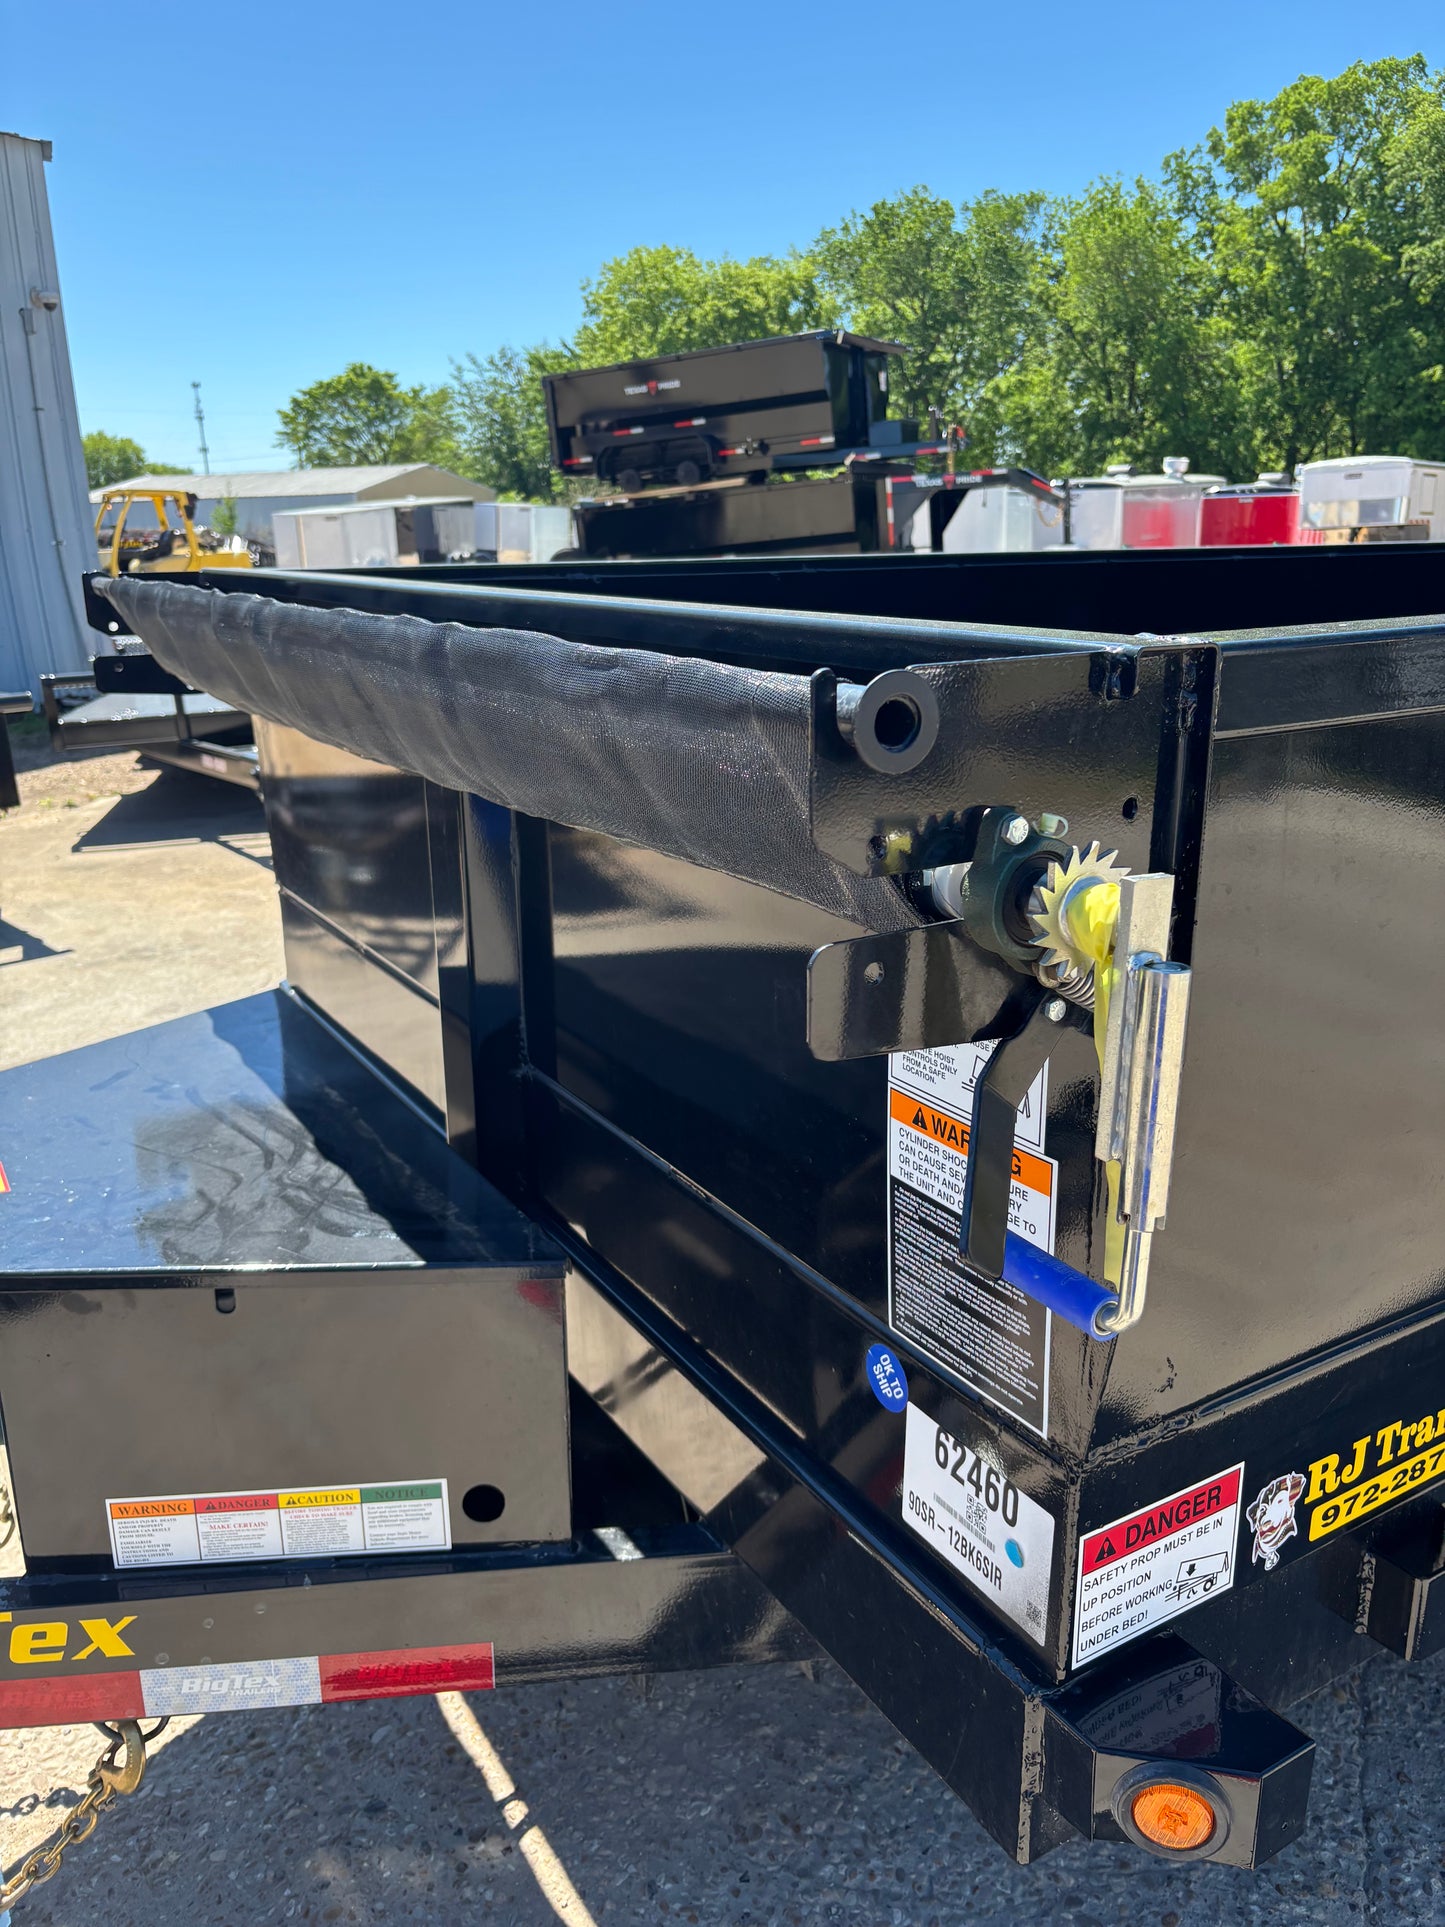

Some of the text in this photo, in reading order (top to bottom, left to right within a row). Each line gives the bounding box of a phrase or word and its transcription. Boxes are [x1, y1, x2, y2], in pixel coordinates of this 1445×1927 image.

[902, 1054, 922, 1068] FROM
[928, 1066, 946, 1080] SAFE
[904, 1050, 938, 1067] ONTROLS
[939, 1063, 958, 1076] ONLY
[934, 1049, 956, 1065] HOIST
[902, 1063, 937, 1085] LOCATION.
[899, 1127, 940, 1155] CYLINDER
[899, 1140, 916, 1157] CAN
[917, 1148, 947, 1174] CAUSE
[899, 1153, 912, 1168] OR
[912, 1160, 940, 1184] DEATH
[898, 1166, 914, 1183] THE
[916, 1175, 936, 1194] UNIT
[936, 1186, 956, 1206] AND
[1022, 1219, 1037, 1235] TO
[873, 1363, 893, 1398] SHIP
[880, 1354, 904, 1399] OK TO
[935, 1425, 1019, 1528] 62460
[1304, 1435, 1371, 1505] RJ
[218, 1498, 270, 1510] DANGER
[297, 1492, 354, 1505] CAUTION
[375, 1487, 429, 1499] NOTICE
[117, 1502, 187, 1516] WARNING
[1125, 1485, 1222, 1549] DANGER
[1083, 1516, 1223, 1592] SAFETY PROP MUST BE IN
[1081, 1579, 1173, 1633] BEFORE WORKING
[1083, 1570, 1152, 1612] UP POSITION
[1080, 1610, 1148, 1652] UNDER BED!
[181, 1674, 281, 1694] BigTex
